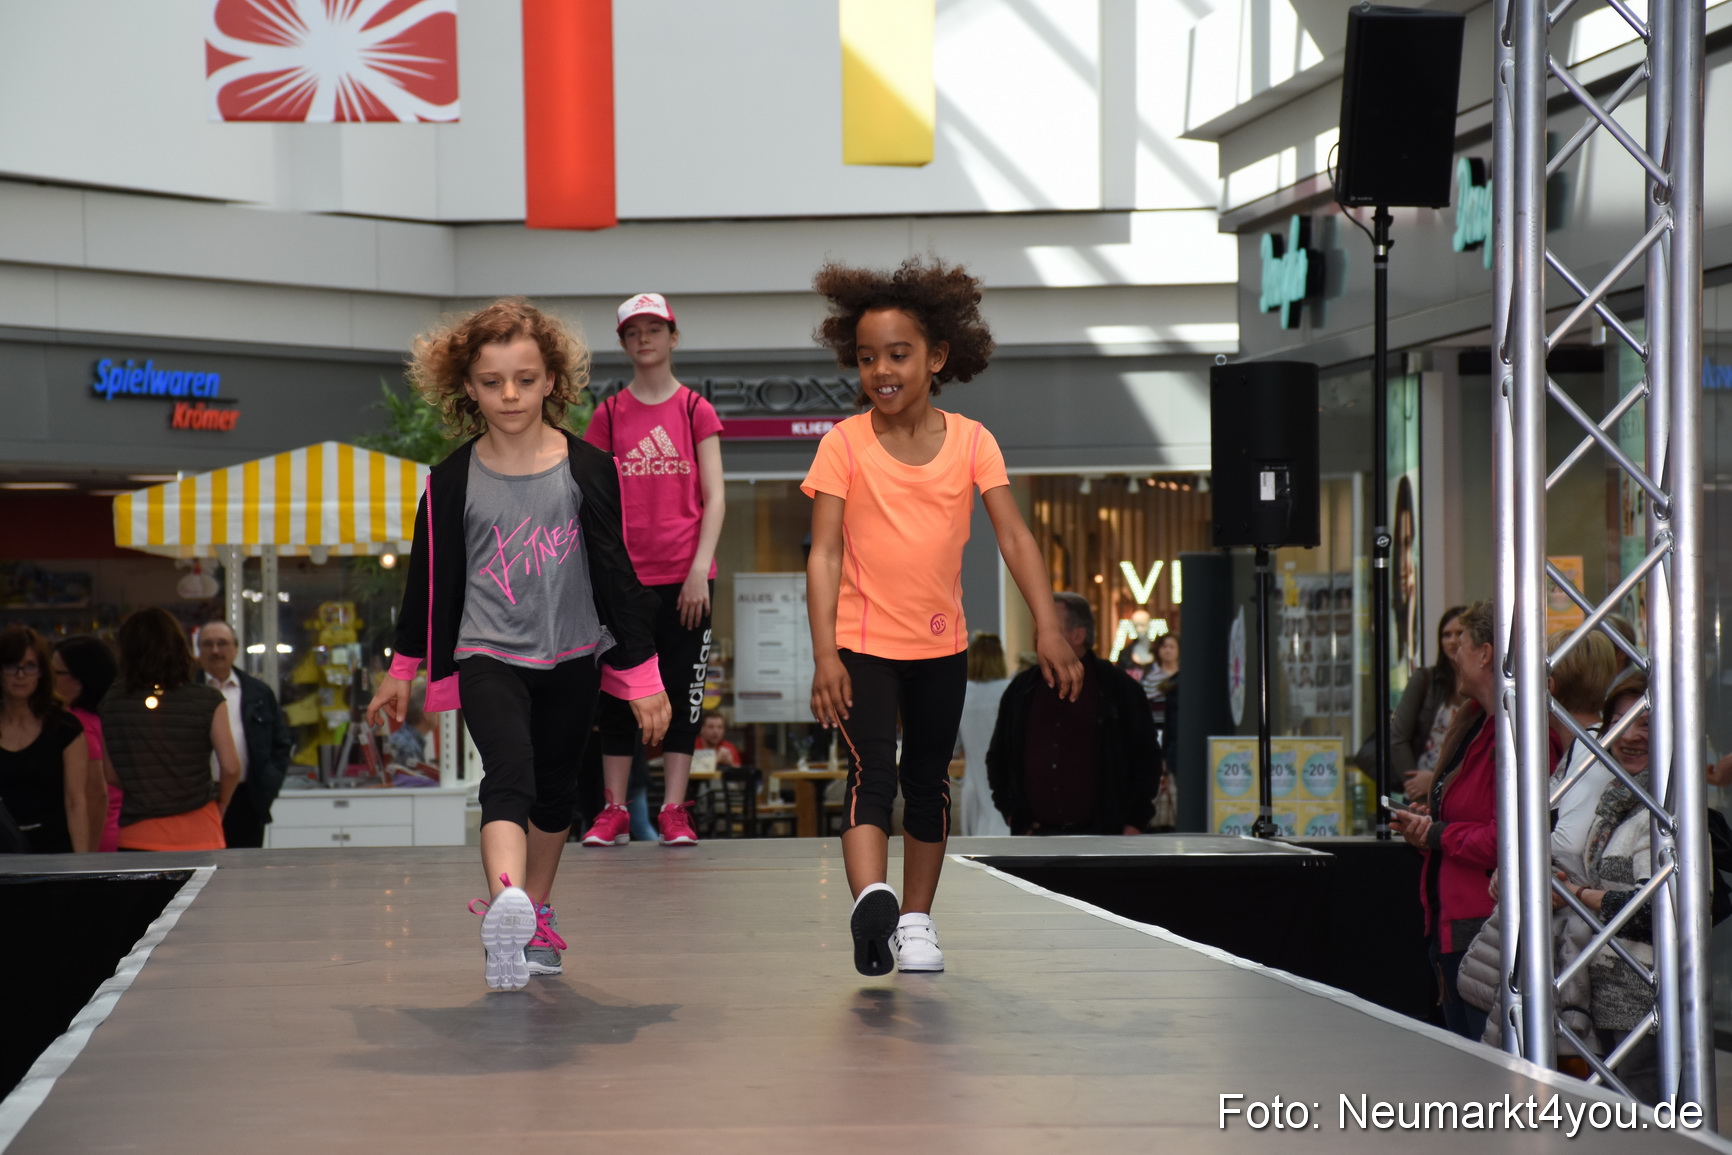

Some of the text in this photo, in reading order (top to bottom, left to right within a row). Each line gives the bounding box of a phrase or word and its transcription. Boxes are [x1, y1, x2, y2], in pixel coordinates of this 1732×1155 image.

[94, 358, 221, 400] Spielwaren
[172, 402, 240, 430] Krömer
[791, 421, 834, 435] KLIER
[619, 456, 691, 477] adidas
[689, 628, 712, 724] adidas
